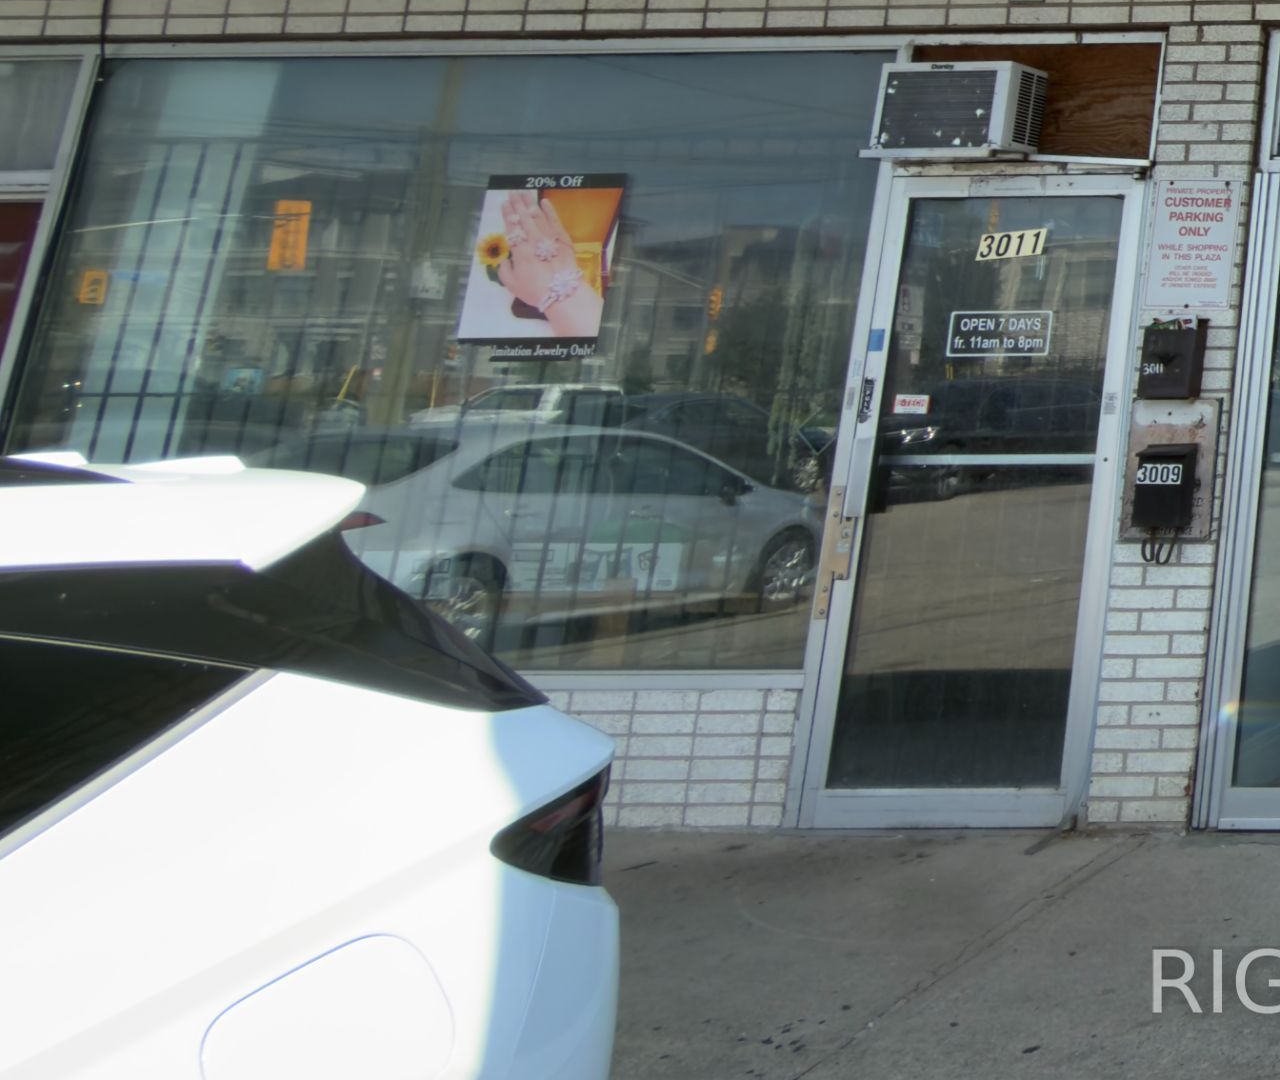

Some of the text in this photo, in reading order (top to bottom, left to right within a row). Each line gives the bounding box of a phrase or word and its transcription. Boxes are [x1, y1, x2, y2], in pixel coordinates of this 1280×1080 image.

[525, 176, 584, 188] 20% Off
[1164, 196, 1232, 208] CUSTOMER
[1168, 211, 1224, 222] PARKING
[1178, 226, 1211, 237] ONLY
[979, 230, 1042, 259] 3011
[1158, 243, 1228, 252] WHILE SHOPPING
[1174, 252, 1192, 261] THIS
[1194, 253, 1222, 261] PLAZA
[960, 317, 1042, 332] OPEN 7 DAYS
[970, 336, 1000, 349] 11am
[1003, 335, 1015, 348] to
[1018, 335, 1044, 351] 8pm
[491, 344, 532, 357] Imitation
[533, 344, 568, 358] Jewelry
[1137, 465, 1181, 483] 3009
